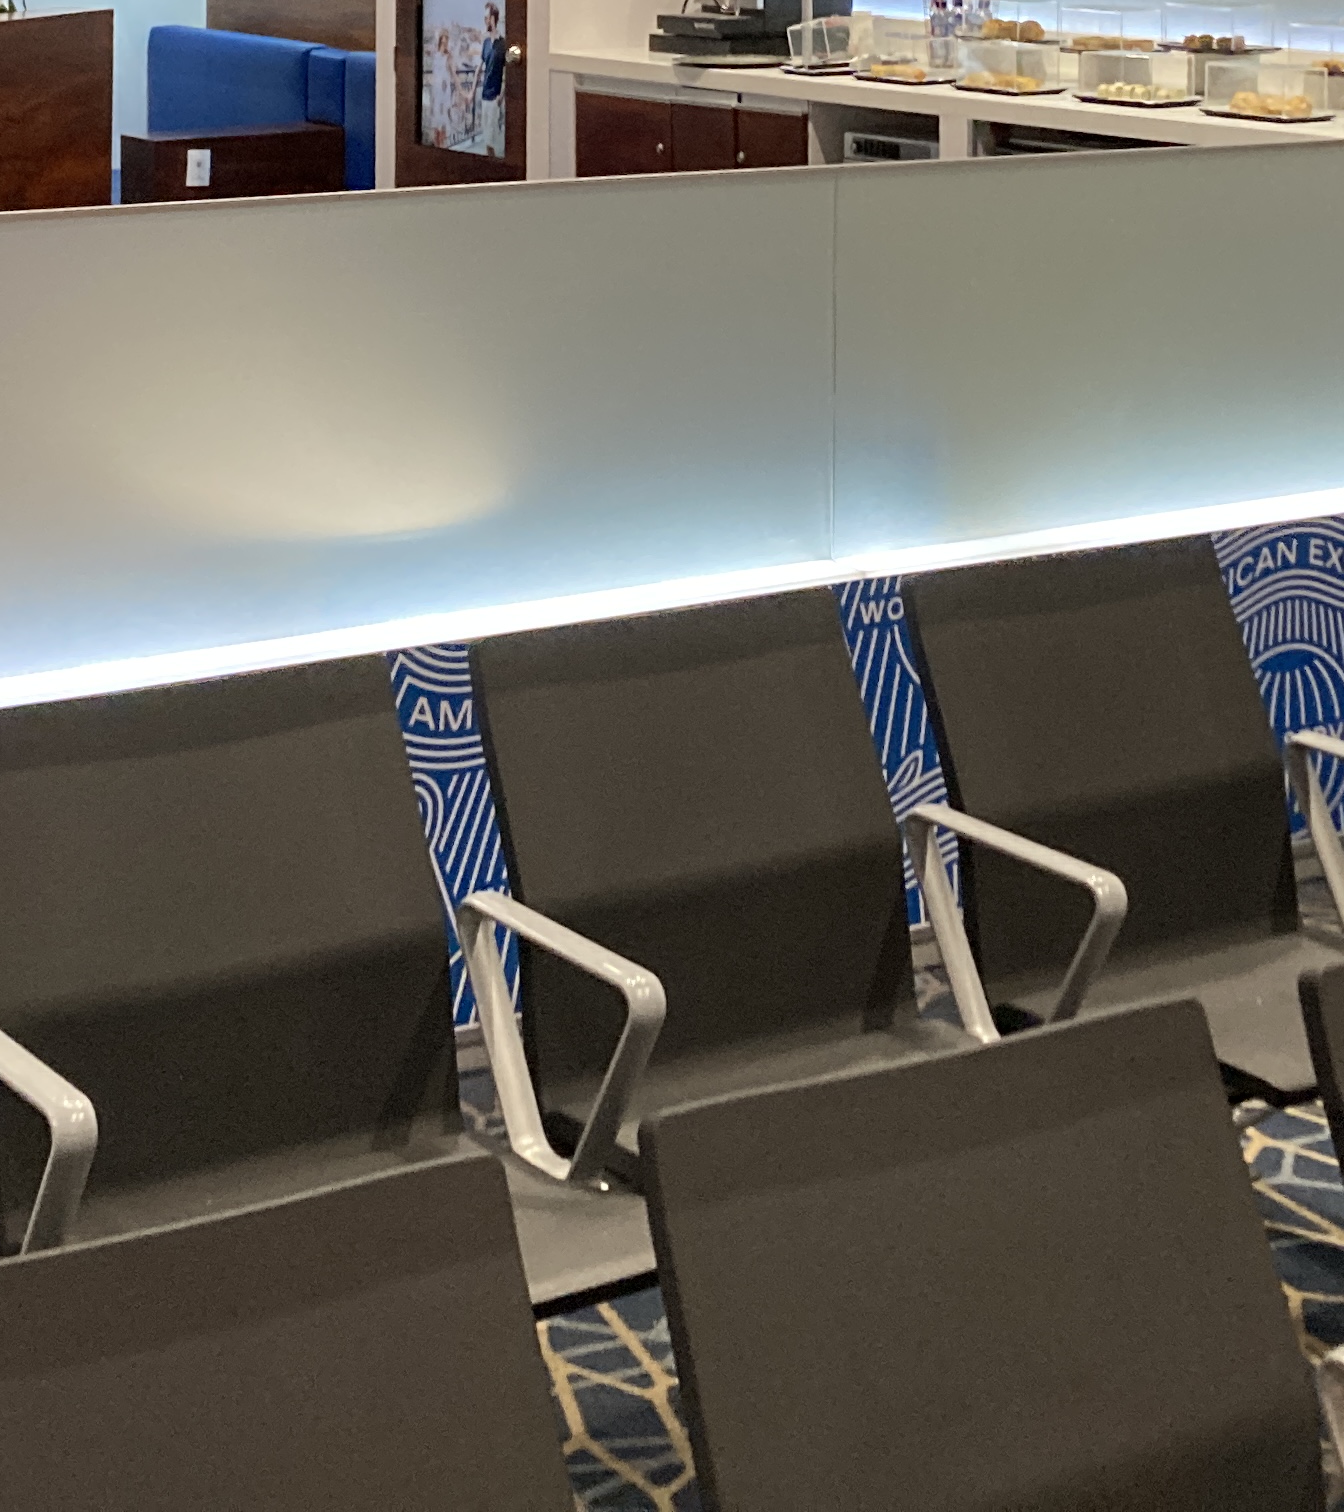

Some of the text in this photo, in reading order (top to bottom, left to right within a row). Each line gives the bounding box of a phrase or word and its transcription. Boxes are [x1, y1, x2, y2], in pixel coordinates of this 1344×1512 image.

[1222, 538, 1298, 594] ICAN
[860, 596, 904, 624] WO
[409, 696, 473, 732] AM
